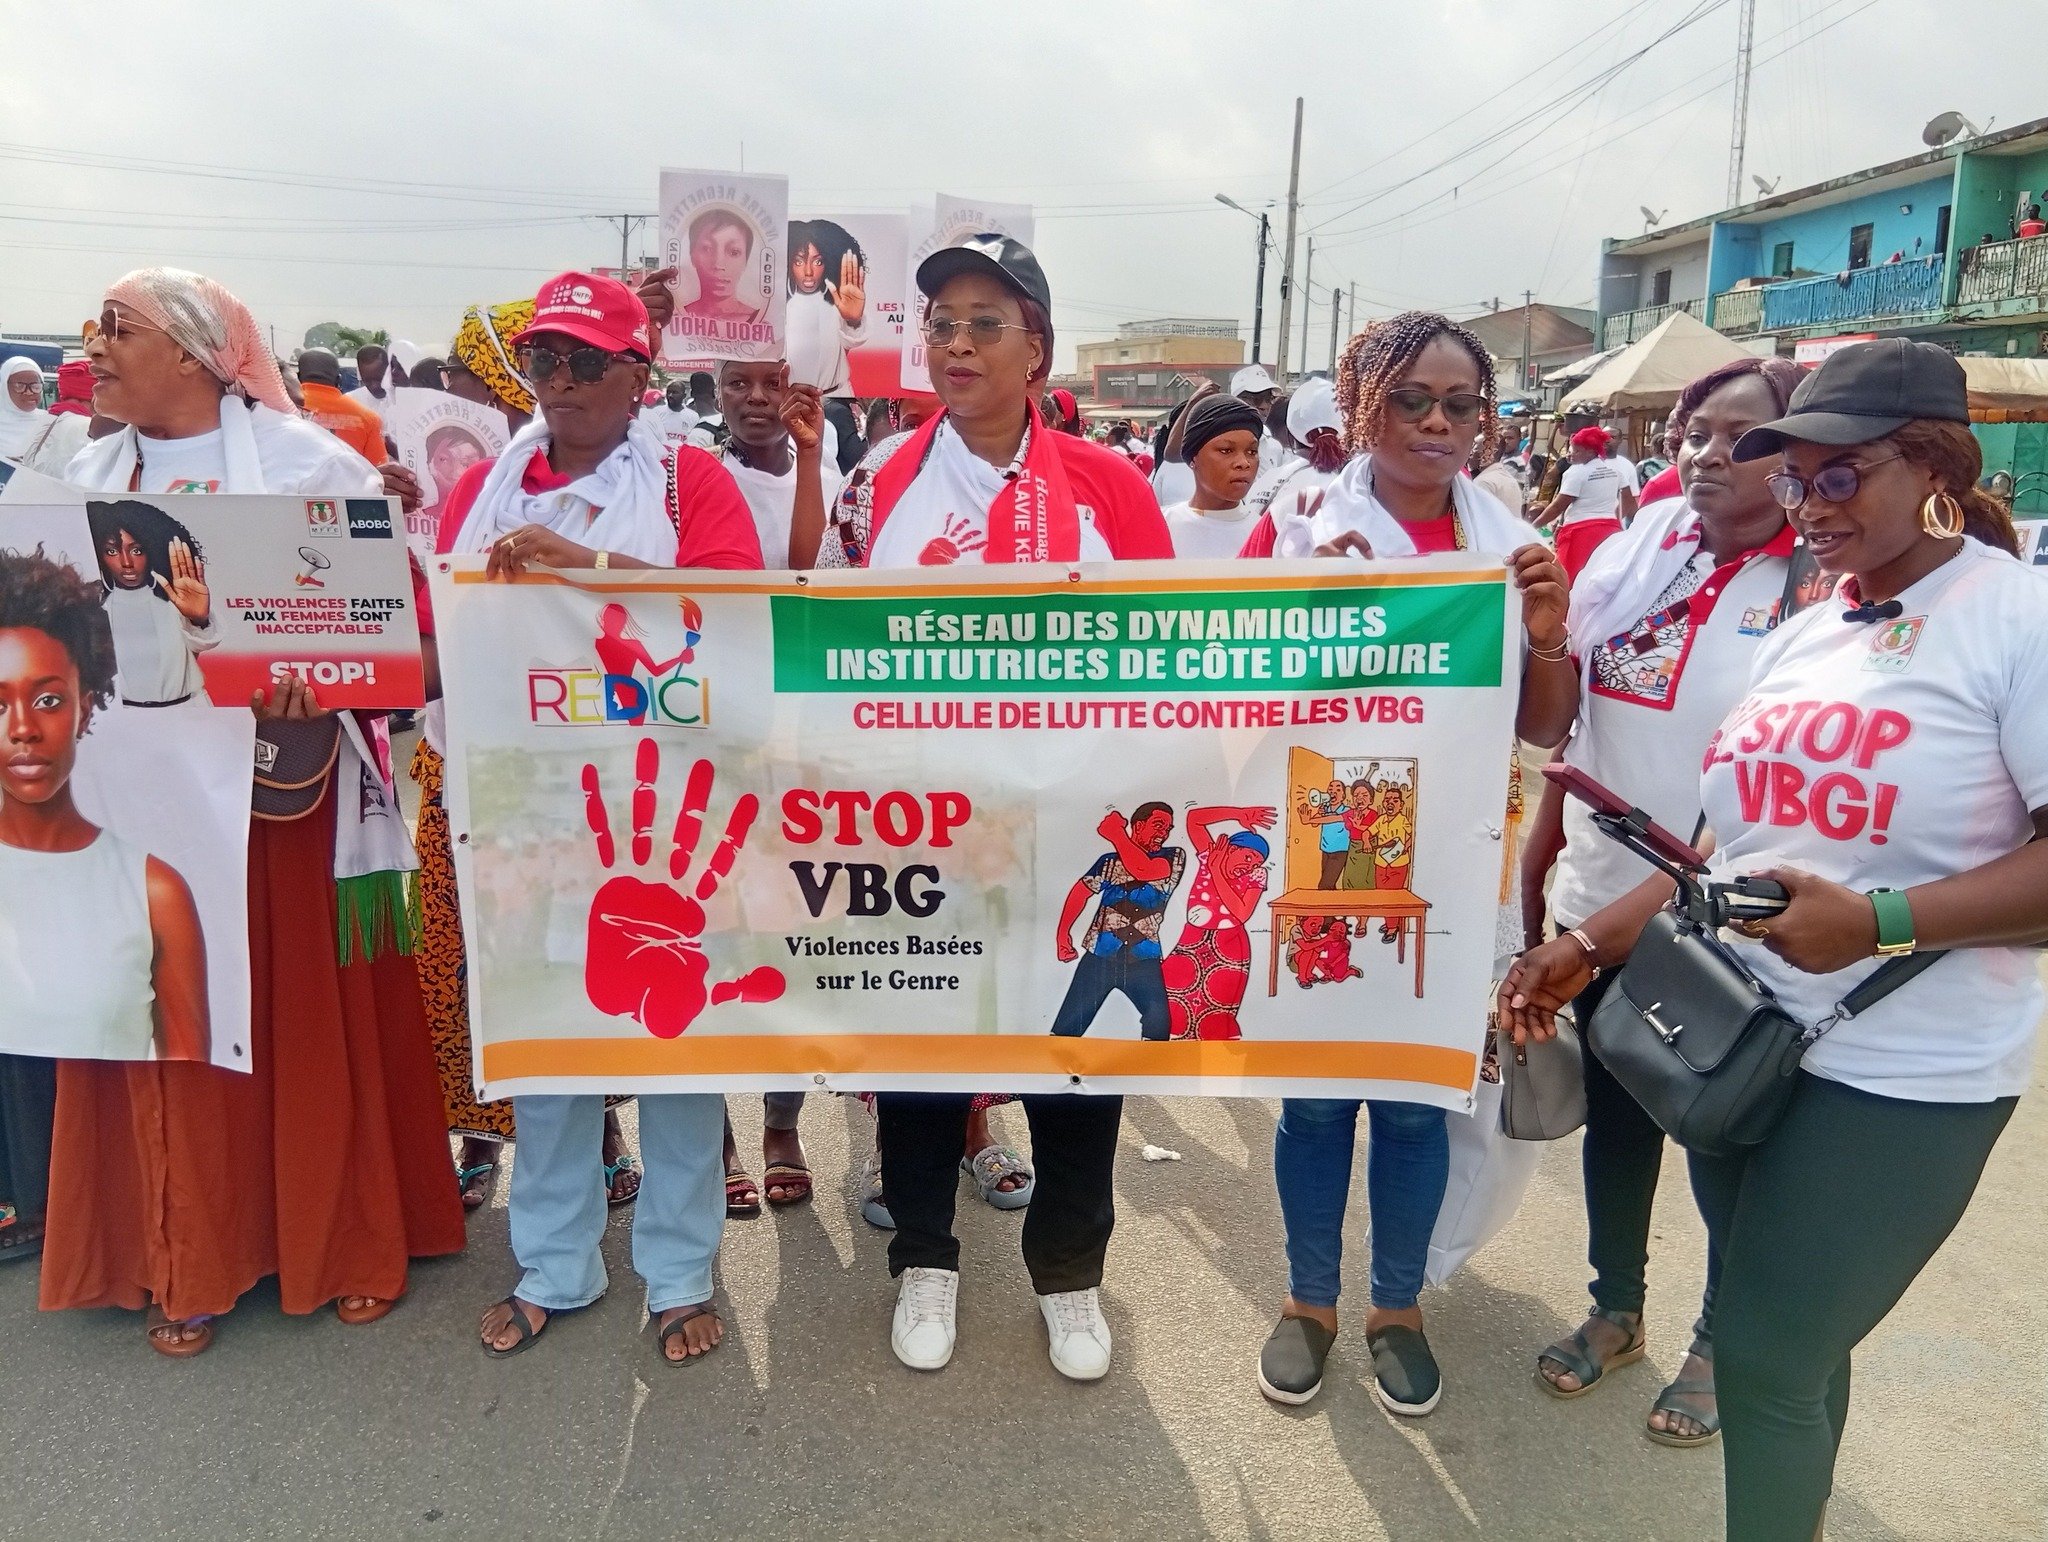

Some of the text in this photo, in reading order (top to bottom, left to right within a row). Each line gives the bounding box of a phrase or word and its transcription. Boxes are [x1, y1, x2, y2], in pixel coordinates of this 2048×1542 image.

[877, 303, 898, 312] LES
[887, 314, 904, 323] AU
[350, 519, 391, 529] ABOBO
[226, 598, 405, 609] LES VIOLENCES FAITES
[243, 611, 393, 622] AUX FEMMES SONT
[887, 606, 1388, 643] RÉSEAU DES DYNAMIQUES
[255, 624, 384, 635] INACCEPTABLES
[826, 640, 1451, 681] INSTITUTRICES DE CÔTE D'IVOIRE
[269, 661, 377, 685] STOP!
[528, 673, 711, 725] REDICI
[853, 695, 1425, 731] CELLULE DE LUTTE CONTRE LES VBG
[1739, 701, 1913, 770] STOP
[1734, 760, 1899, 846] VBG!
[781, 788, 972, 848] STOP
[789, 861, 946, 918] VBG
[785, 934, 984, 957] Violences Basées
[816, 970, 960, 991] sur le Genre
